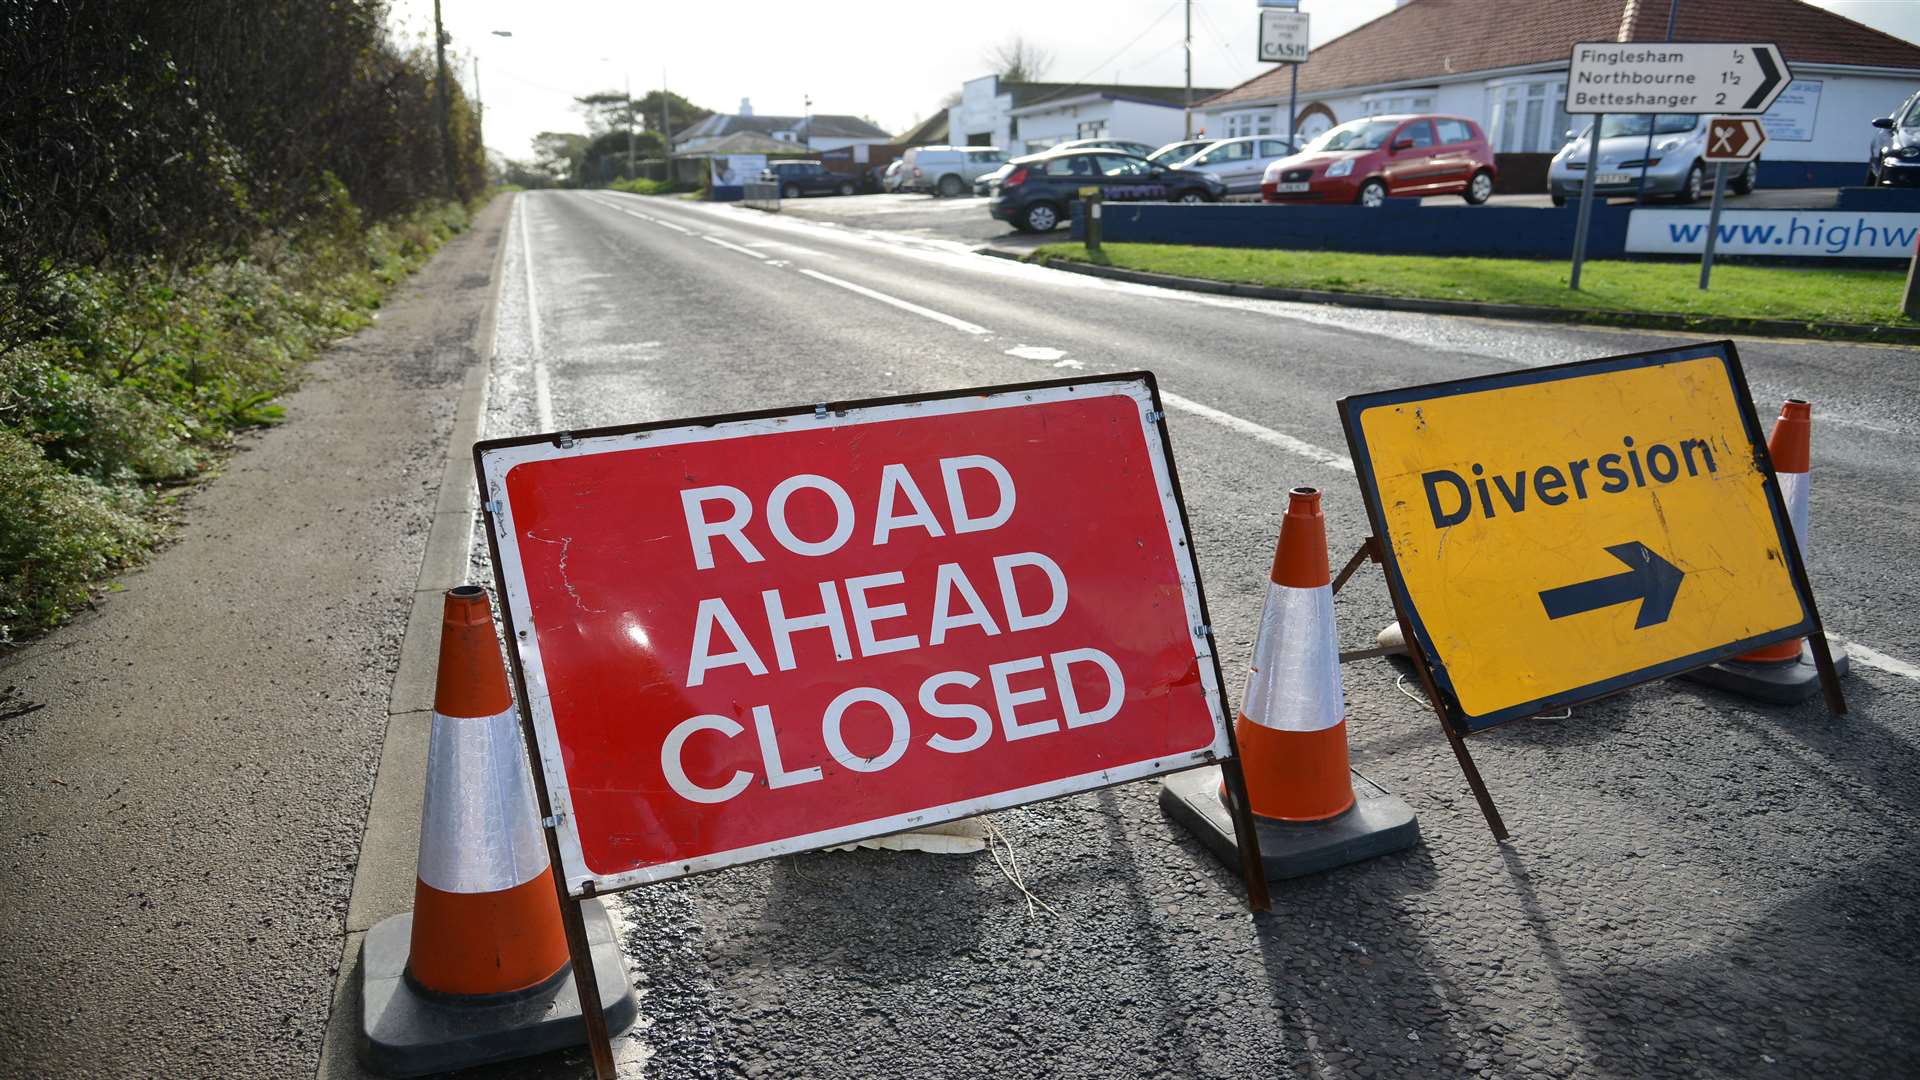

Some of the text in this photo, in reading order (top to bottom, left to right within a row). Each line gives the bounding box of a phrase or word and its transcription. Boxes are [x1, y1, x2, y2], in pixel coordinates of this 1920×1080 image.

[1264, 42, 1305, 57] CASH
[1580, 50, 1684, 65] Finglesham
[1575, 92, 1727, 107] Betteshanger 2
[1577, 71, 1696, 85] Northbourne
[1422, 435, 1717, 530] Diversion
[680, 454, 1017, 571] ROAD
[686, 551, 1069, 688] AHEAD
[661, 647, 1126, 804] CLOSED
